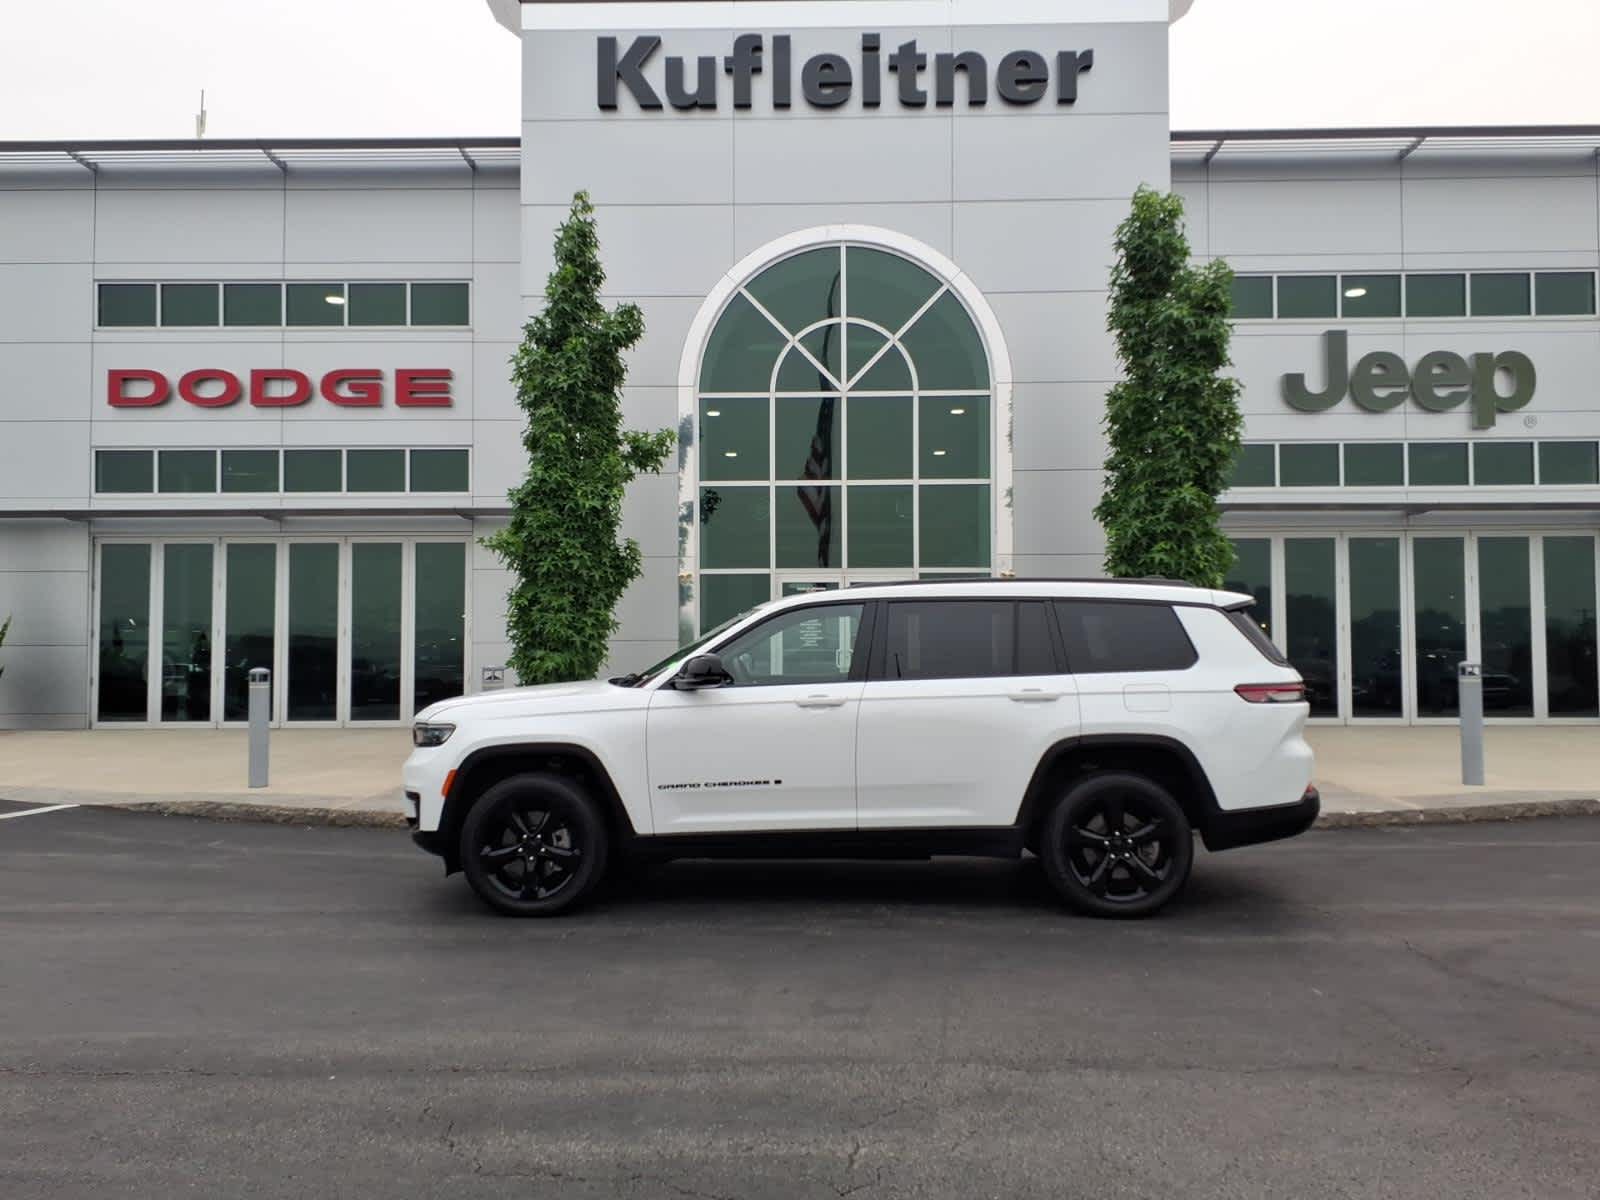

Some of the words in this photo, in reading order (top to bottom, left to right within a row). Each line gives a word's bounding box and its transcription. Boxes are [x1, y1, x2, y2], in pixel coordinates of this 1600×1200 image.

[597, 33, 1094, 110] Kufleitner
[108, 369, 454, 408] DODGE
[1282, 329, 1536, 430] Jeep
[657, 782, 701, 790] GRAND
[704, 779, 770, 788] CHEROKEE
